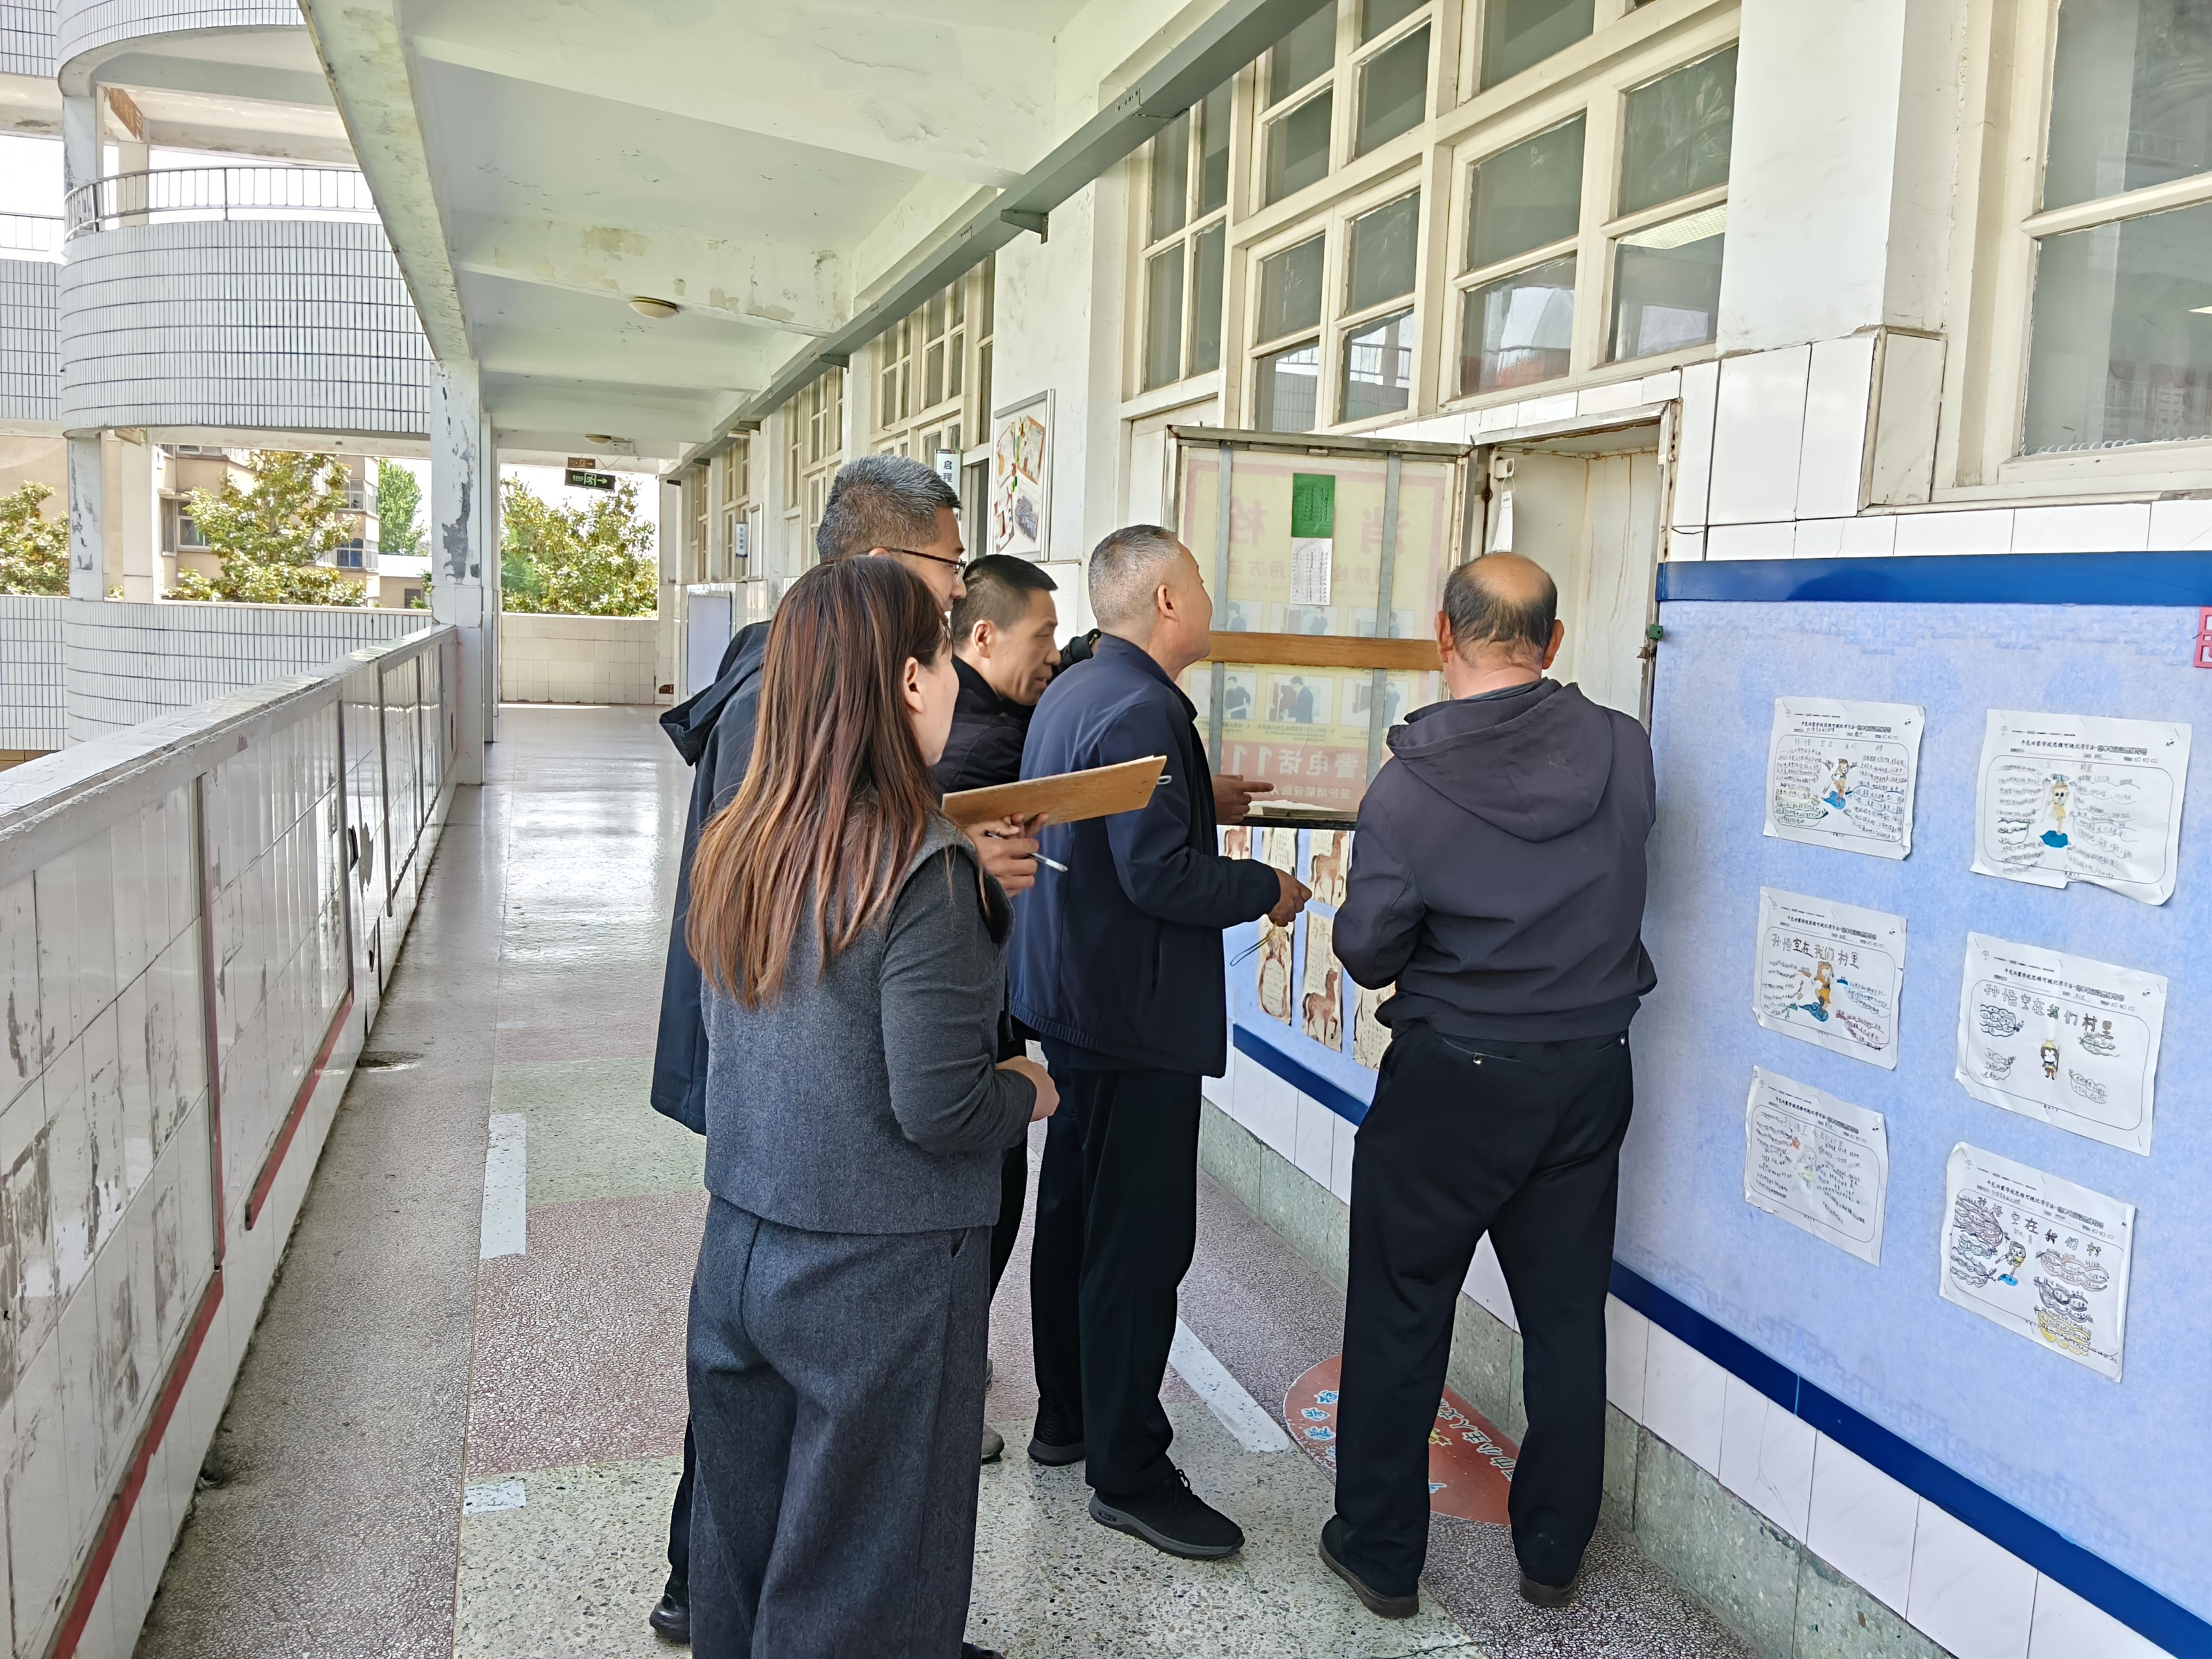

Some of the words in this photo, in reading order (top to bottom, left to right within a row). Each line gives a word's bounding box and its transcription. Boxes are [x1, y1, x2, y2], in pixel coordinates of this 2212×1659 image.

[1984, 984, 2114, 1040] 孙悟空在我们村里
